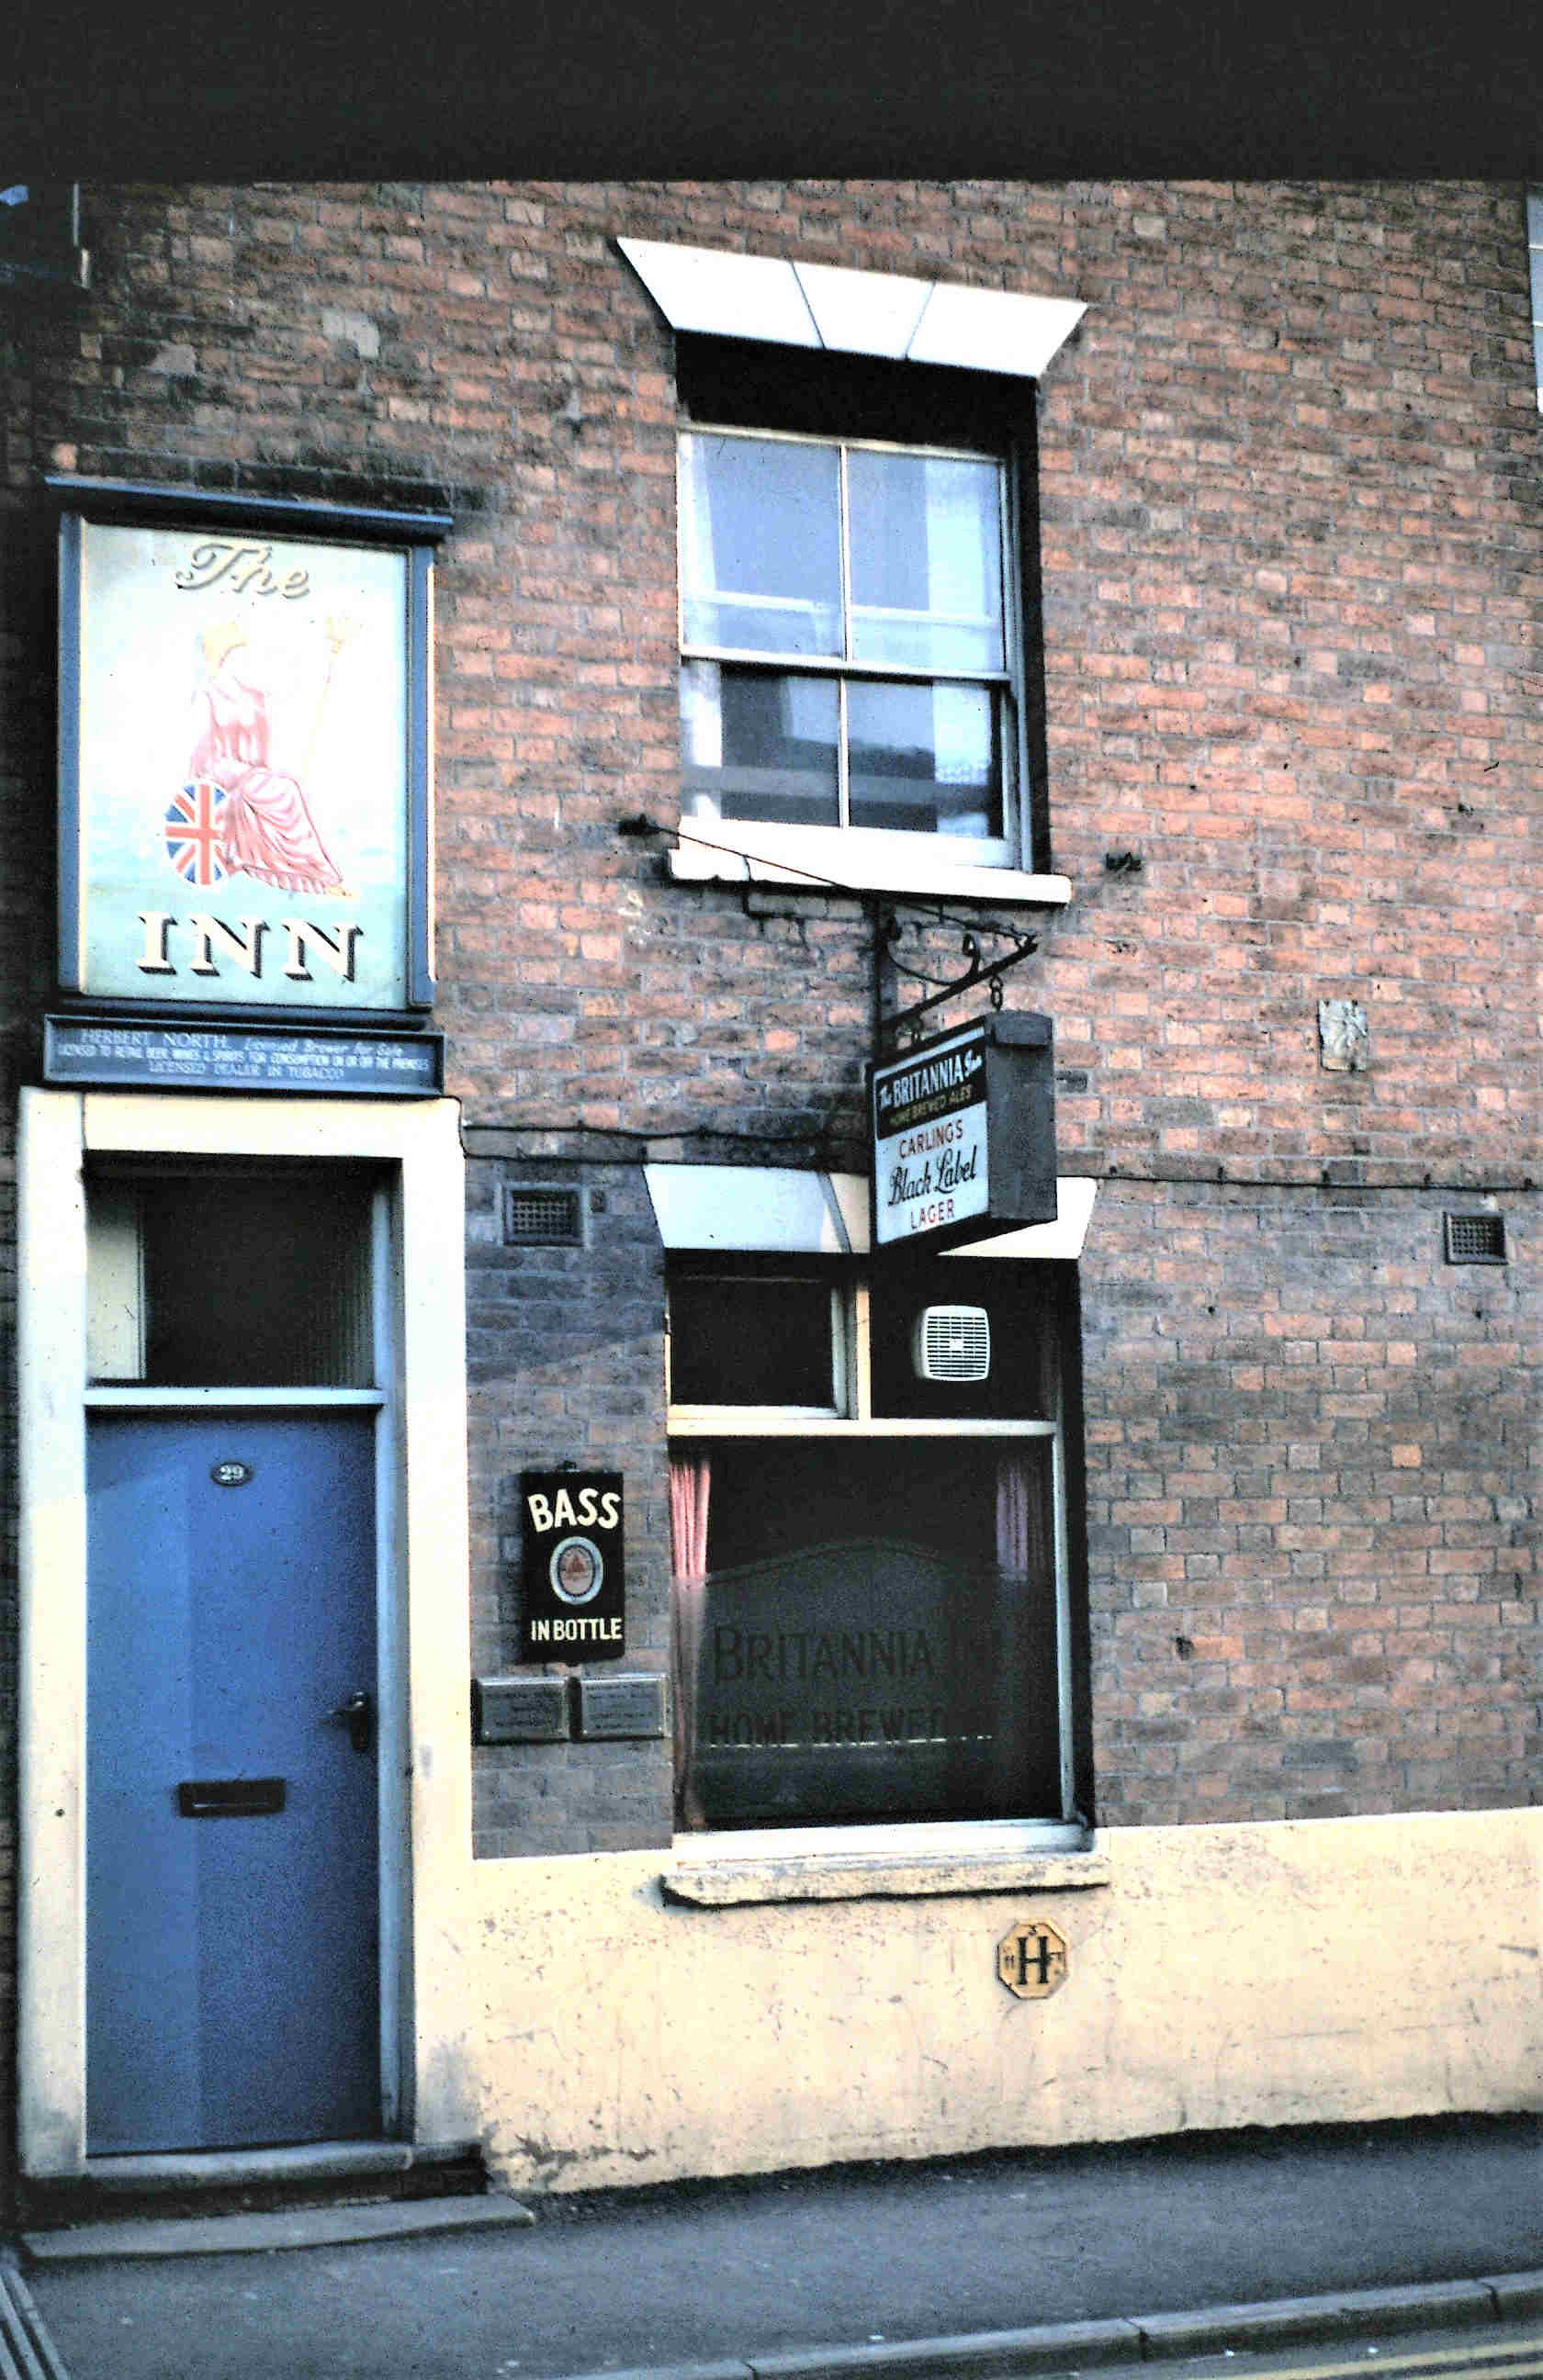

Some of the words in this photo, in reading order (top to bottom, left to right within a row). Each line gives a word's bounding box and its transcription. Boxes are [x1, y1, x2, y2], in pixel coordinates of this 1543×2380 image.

[171, 540, 310, 599] The
[136, 910, 364, 982] INN
[81, 1028, 152, 1045] HERBERT
[893, 1055, 963, 1108] BRITANNIA
[888, 1161, 931, 1207] Black
[934, 1144, 977, 1194] Label
[910, 1198, 955, 1230] LAGER
[220, 1465, 244, 1481] 29
[527, 1488, 621, 1532] BASS
[531, 1620, 549, 1641] IN
[554, 1618, 624, 1641] BOTTLE
[713, 1623, 936, 1688] BRITANNIA
[1016, 1936, 1049, 1985] H
